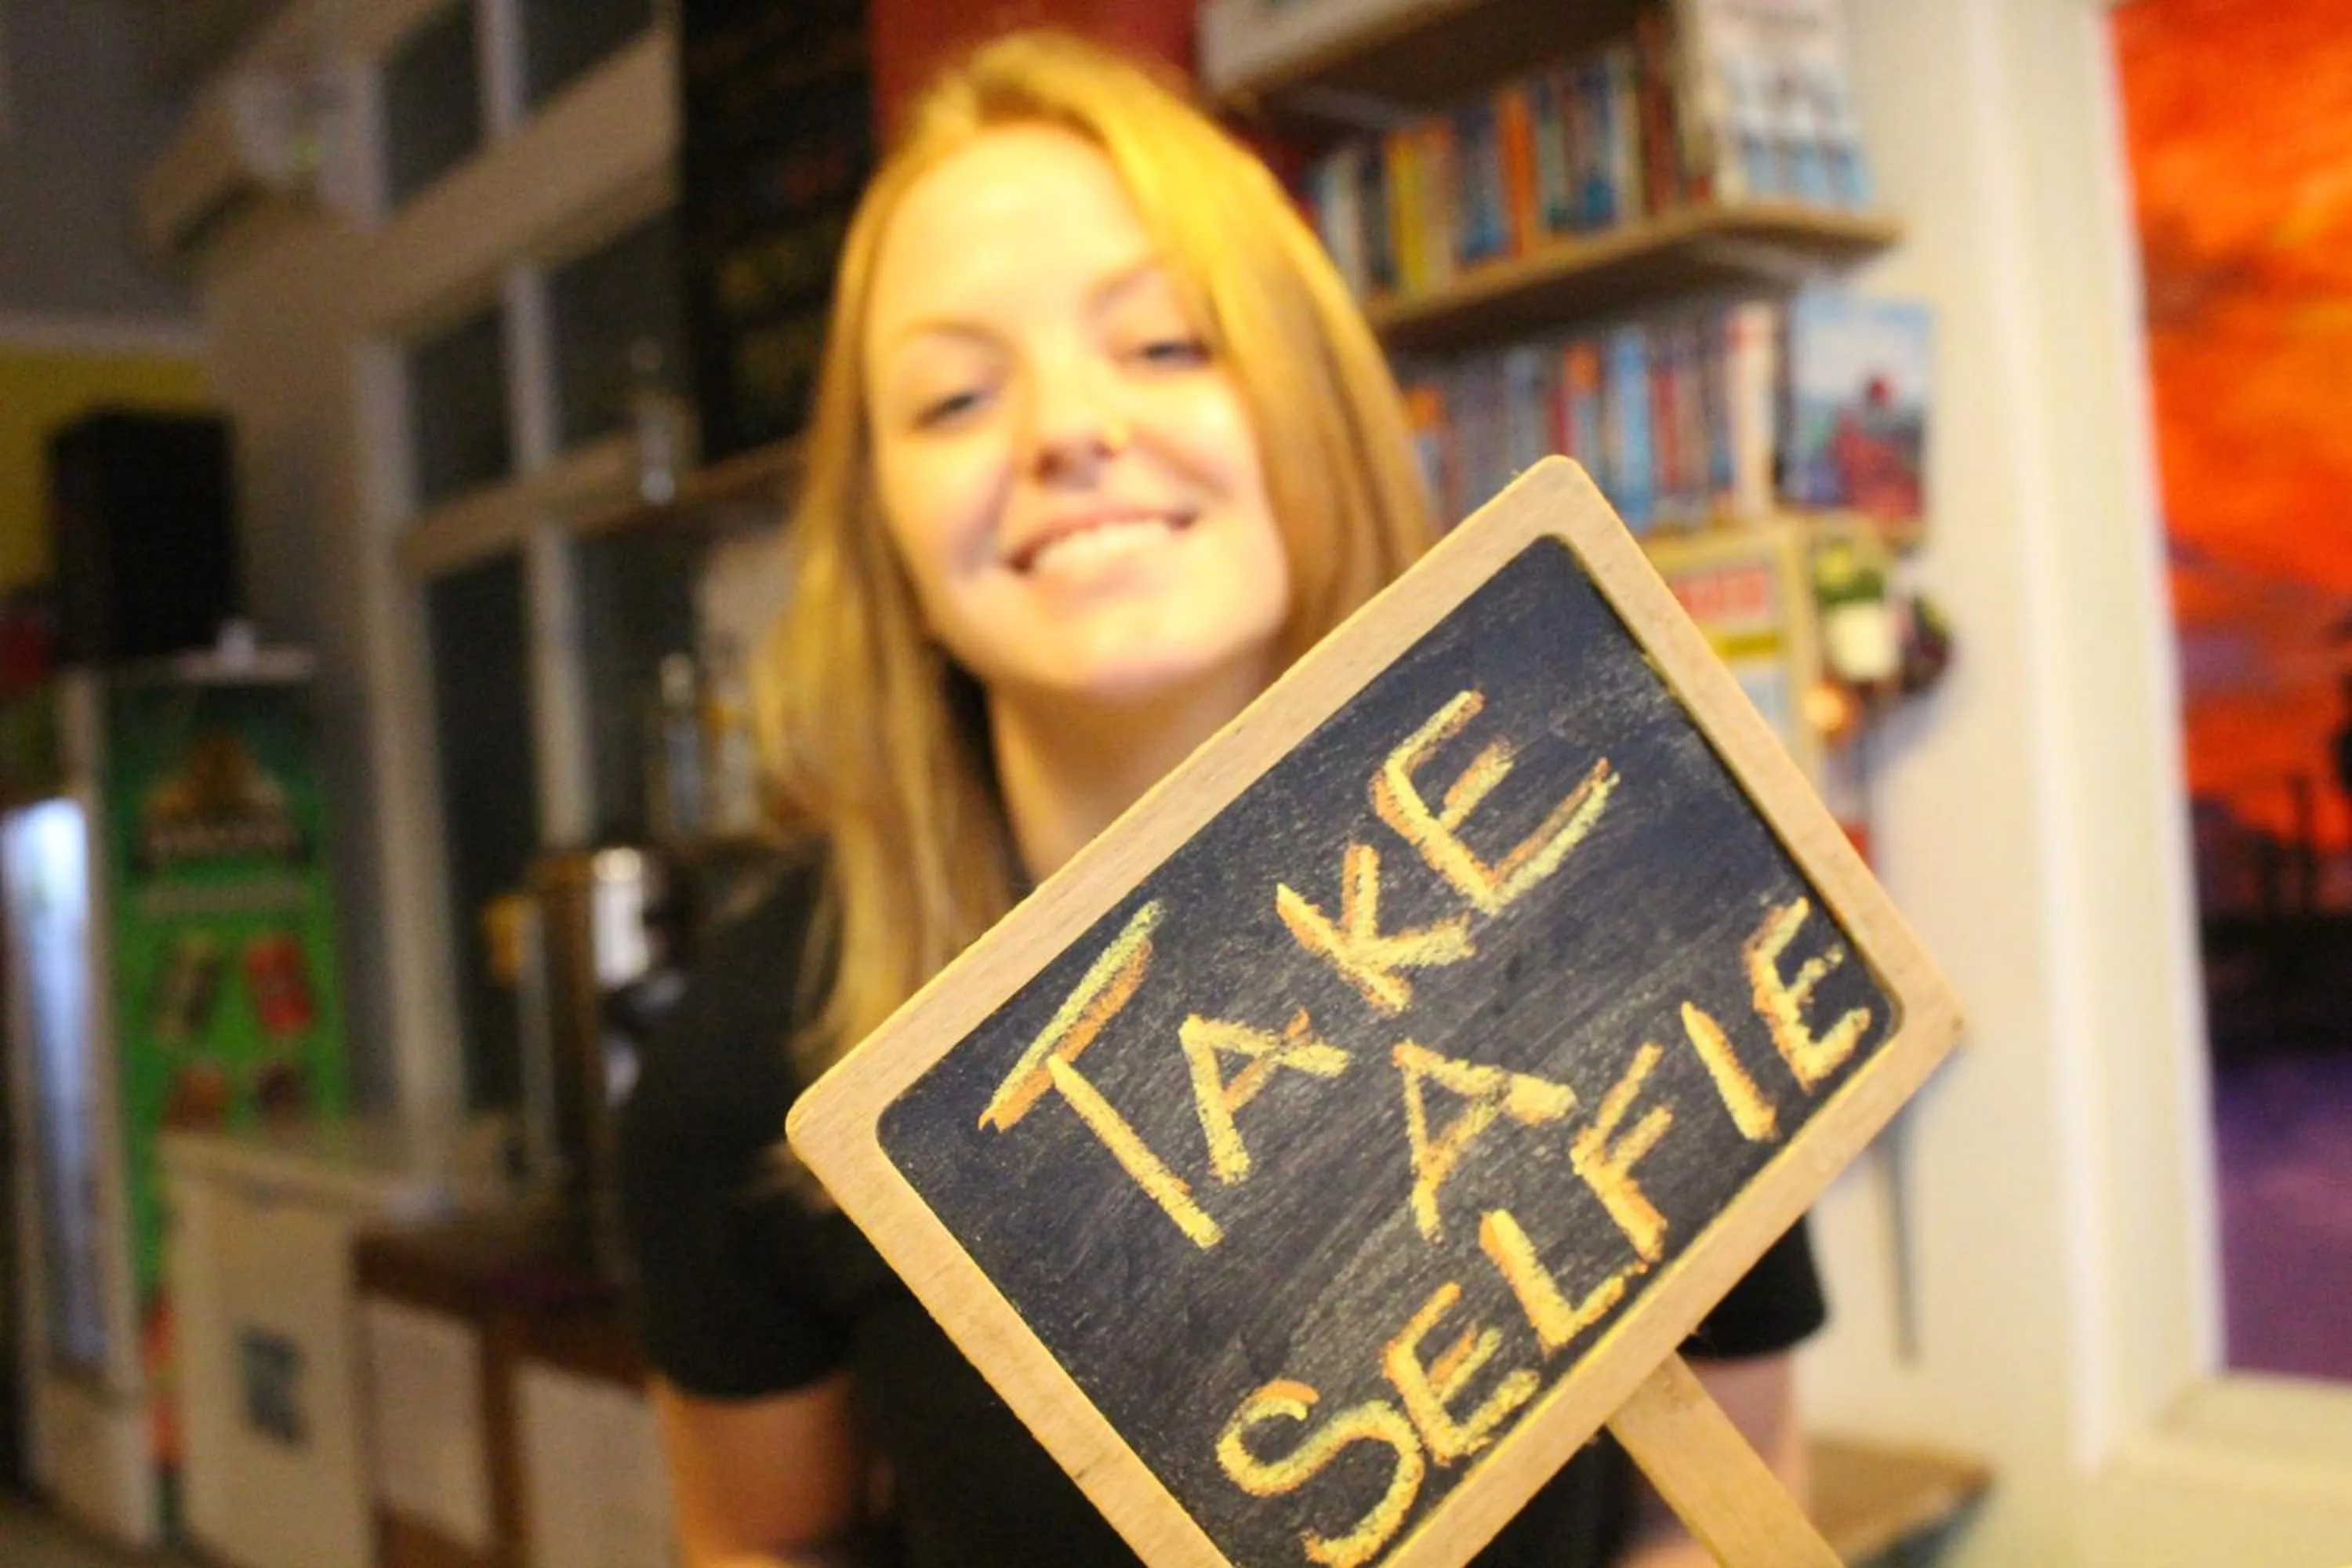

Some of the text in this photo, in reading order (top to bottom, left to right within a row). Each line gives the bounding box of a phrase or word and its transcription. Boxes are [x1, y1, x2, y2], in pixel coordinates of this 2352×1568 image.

[979, 689, 1620, 1249] TAKE
[1216, 897, 1871, 1568] SELFIE
[1393, 1040, 1577, 1243] A
